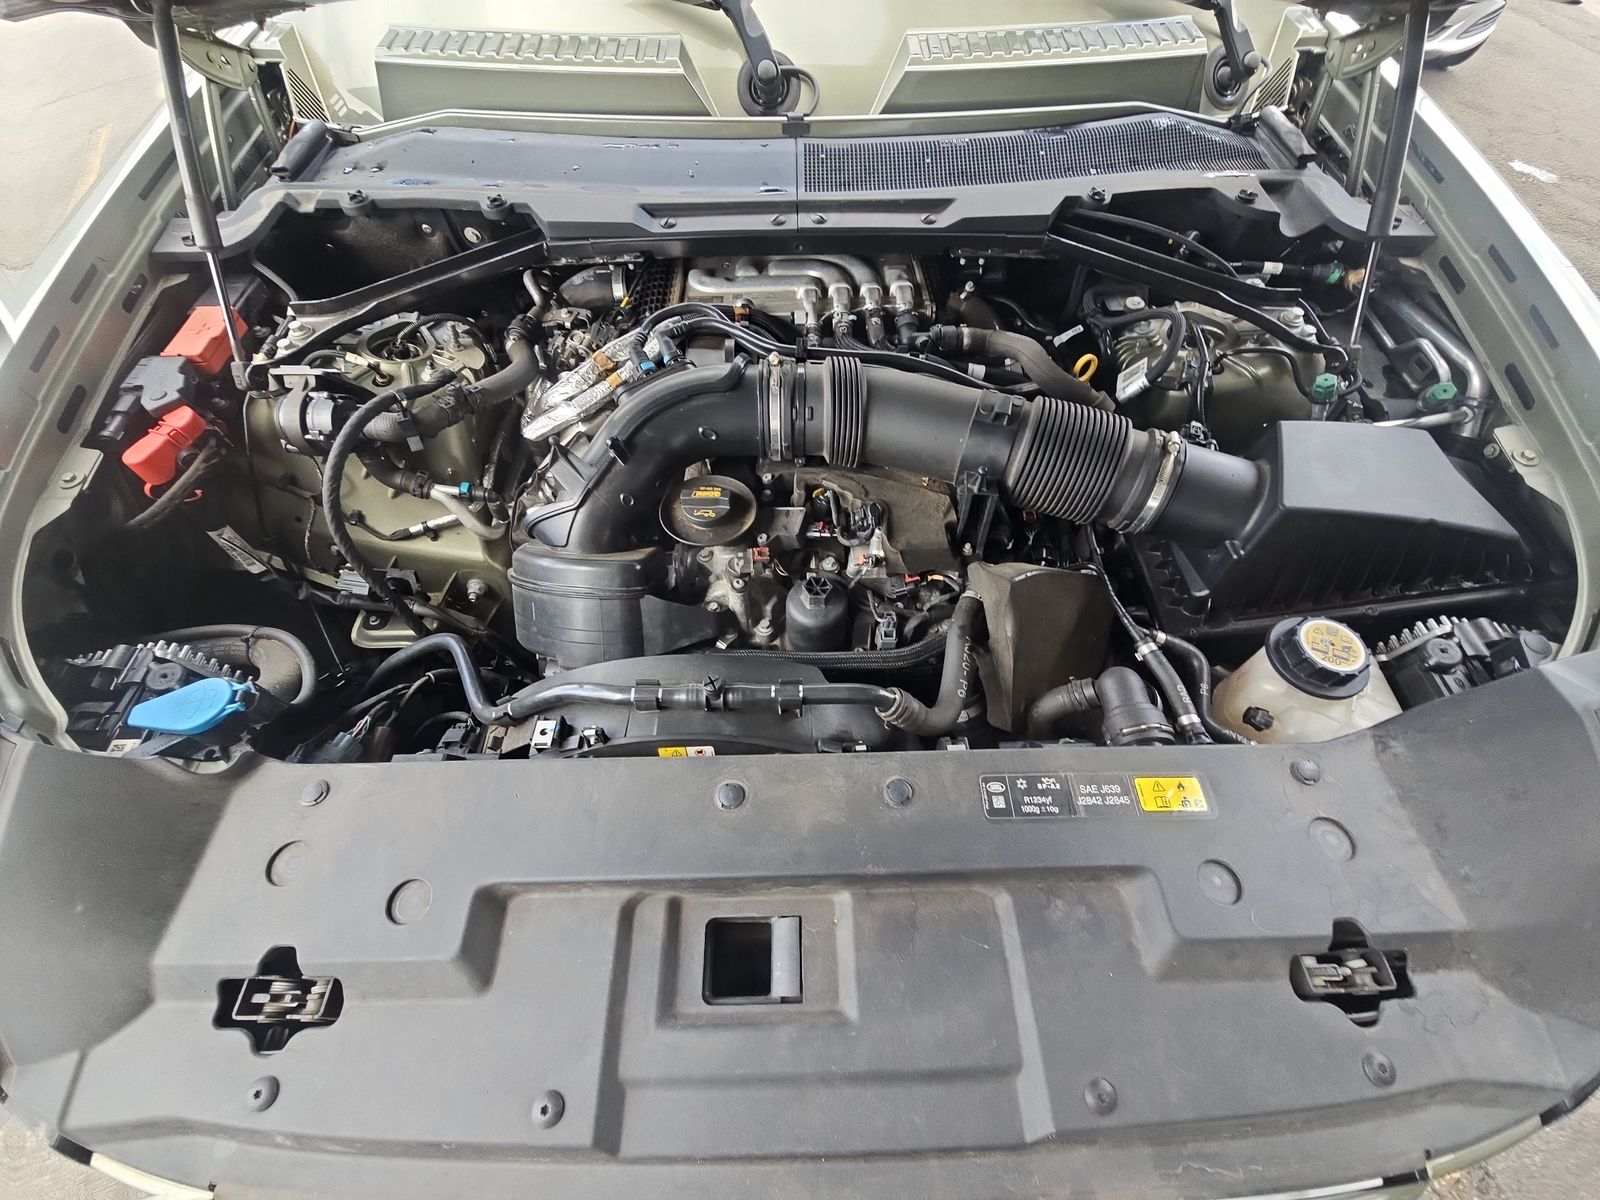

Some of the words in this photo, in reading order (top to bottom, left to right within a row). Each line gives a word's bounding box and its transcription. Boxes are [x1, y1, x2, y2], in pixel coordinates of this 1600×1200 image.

[1321, 654, 1342, 665] 200
[1079, 784, 1100, 794] SAE
[1100, 784, 1122, 794] J639
[1023, 795, 1053, 805] R1234yf
[1077, 795, 1103, 806] J2842
[1104, 795, 1131, 805] J2845
[1020, 804, 1040, 814] 1000g
